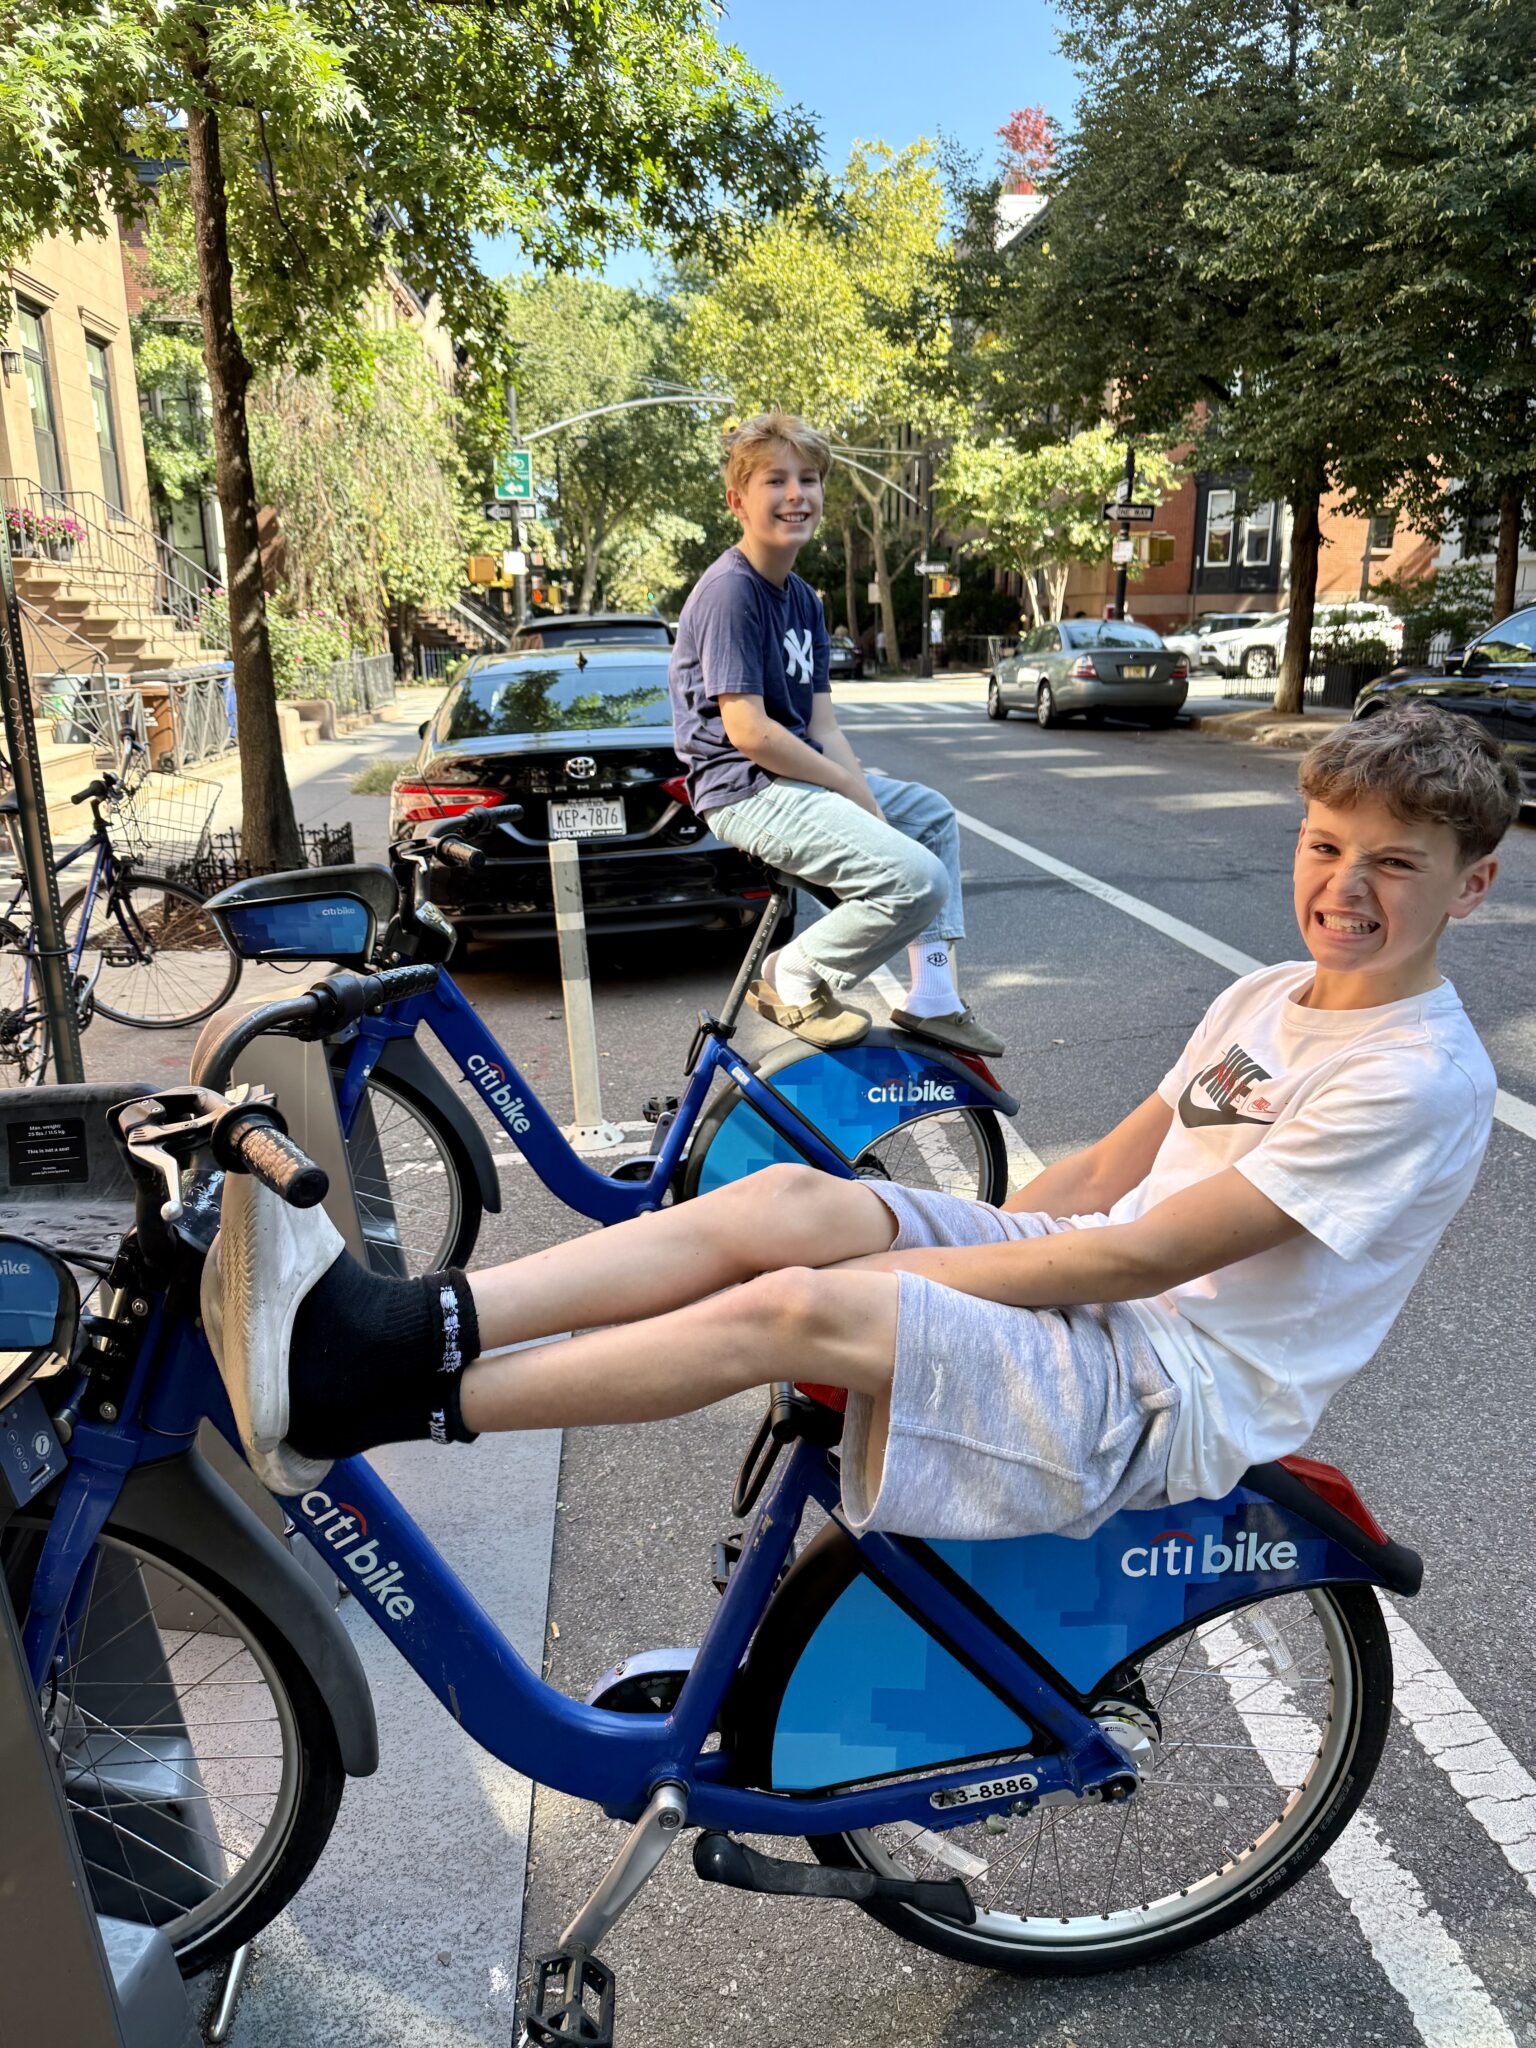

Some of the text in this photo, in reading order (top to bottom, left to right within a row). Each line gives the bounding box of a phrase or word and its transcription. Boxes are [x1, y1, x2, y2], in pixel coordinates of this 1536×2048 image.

[783, 628, 814, 684] NY
[556, 807, 618, 829] KEP 7876
[322, 906, 355, 916] citi bike
[467, 1054, 531, 1134] citi bike
[867, 1080, 955, 1103] citi bike
[0, 1260, 31, 1275] ike
[300, 1490, 415, 1621] citi bike
[1121, 1530, 1298, 1578] citi bike
[934, 1776, 1033, 1808] 73-8886
